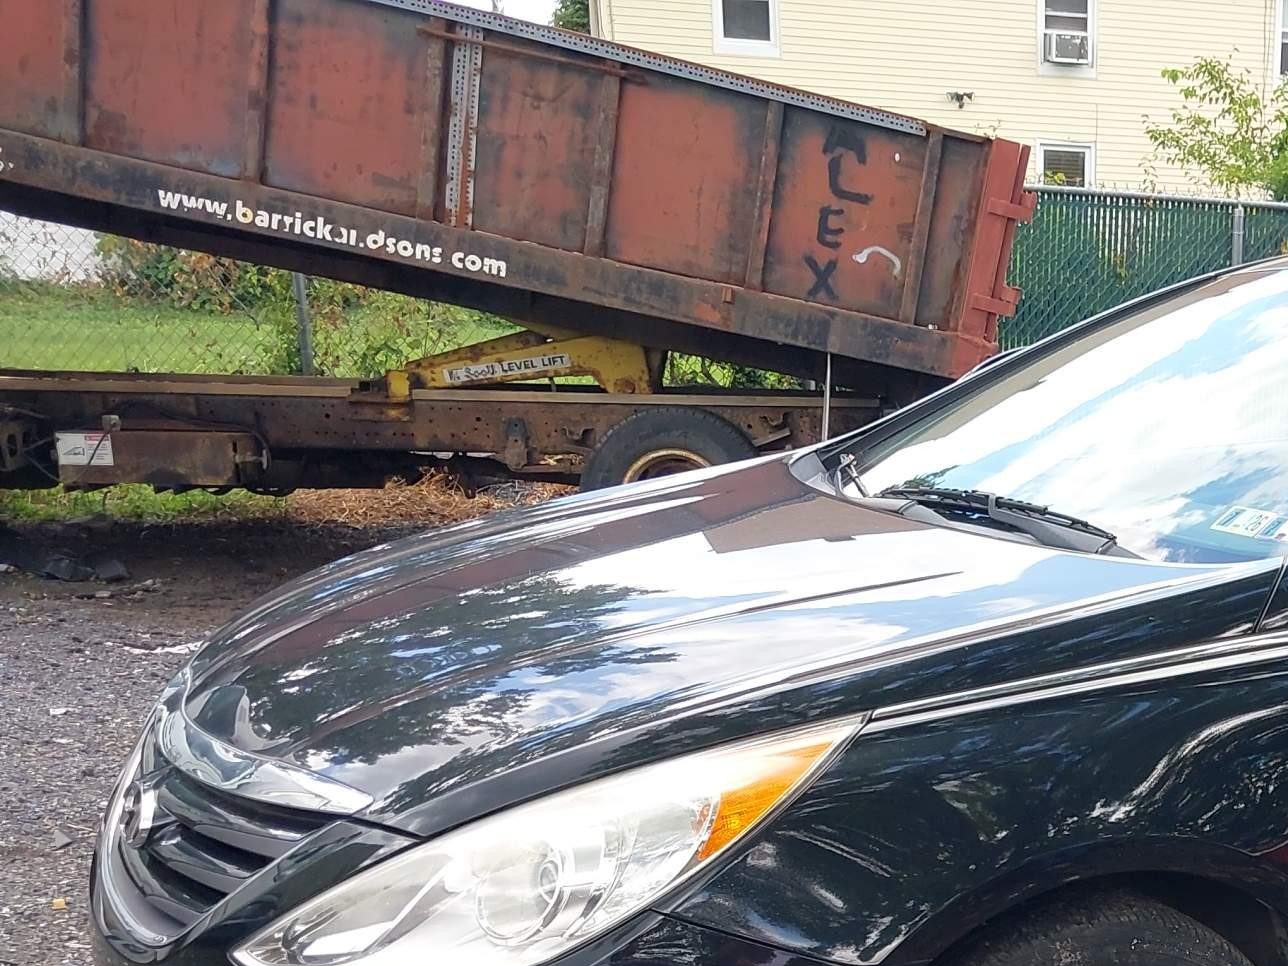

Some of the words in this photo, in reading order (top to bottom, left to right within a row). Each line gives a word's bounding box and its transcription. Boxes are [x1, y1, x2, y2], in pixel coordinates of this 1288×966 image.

[802, 125, 873, 299] ALEX
[500, 359, 538, 373] LEVEL
[541, 355, 566, 367] LIFT
